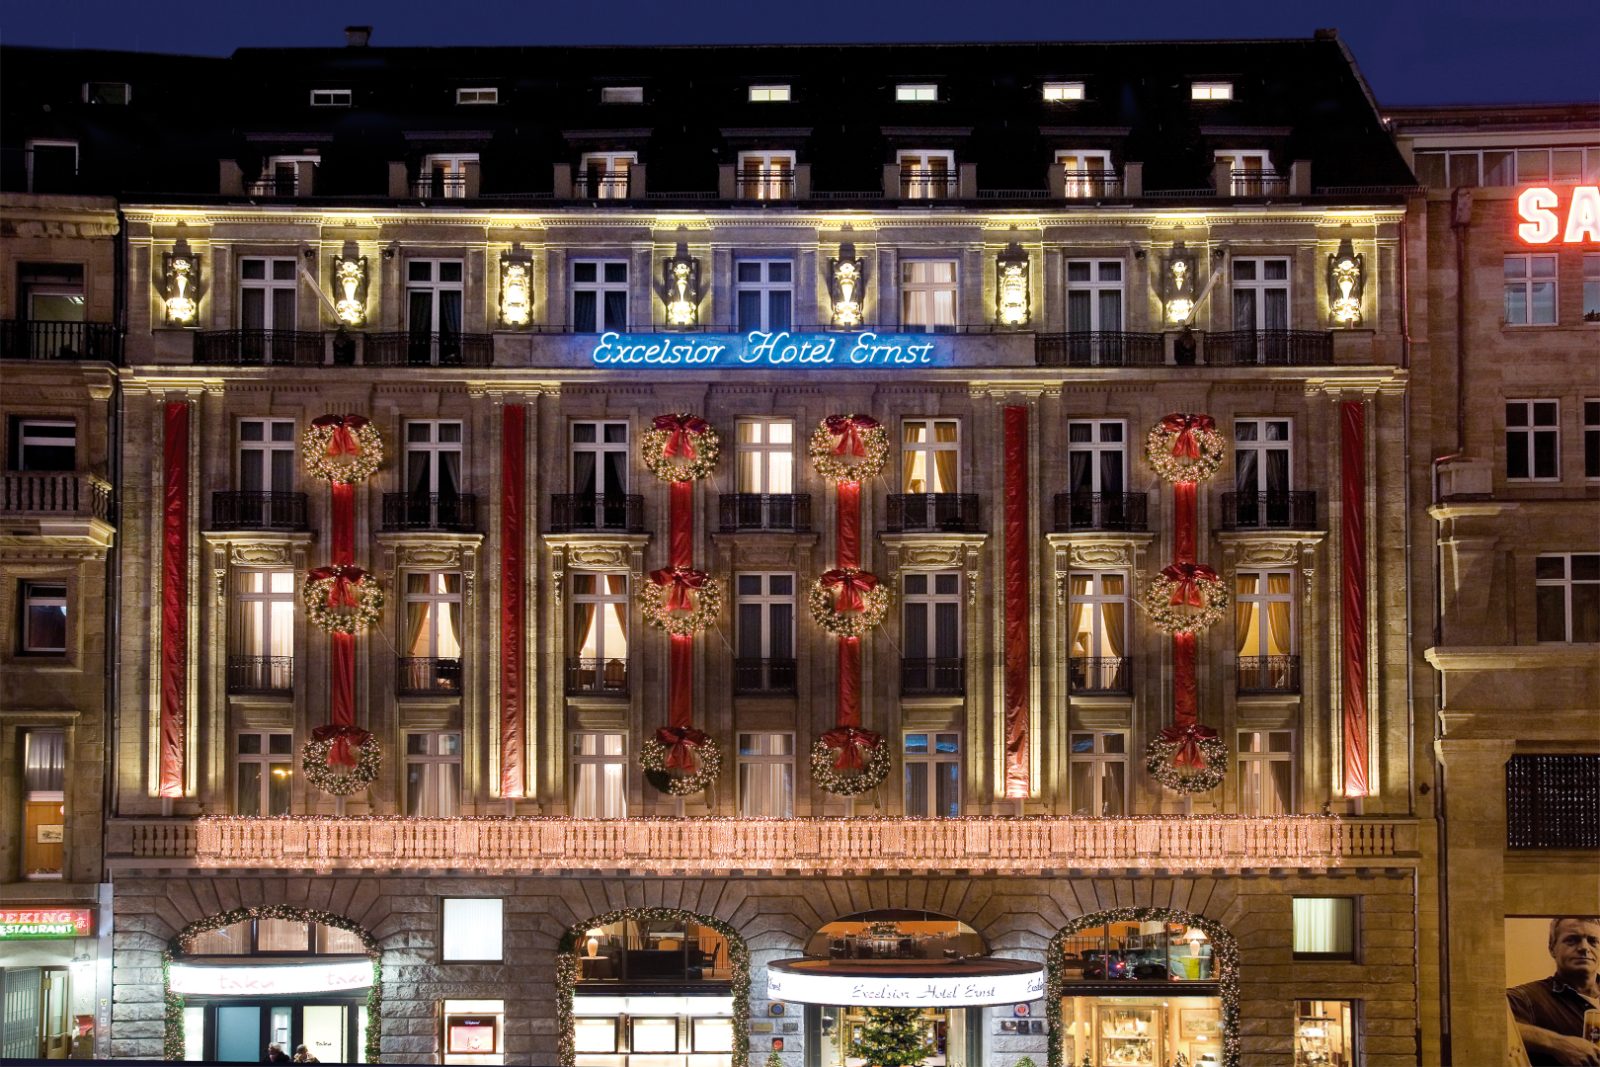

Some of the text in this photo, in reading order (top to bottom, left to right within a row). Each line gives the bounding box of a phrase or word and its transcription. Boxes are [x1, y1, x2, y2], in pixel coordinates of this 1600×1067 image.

[592, 330, 934, 364] Excelsior Hotel Ernst
[0, 924, 72, 935] ESTAURANT
[851, 983, 996, 999] Excelsior Hotel Ernst
